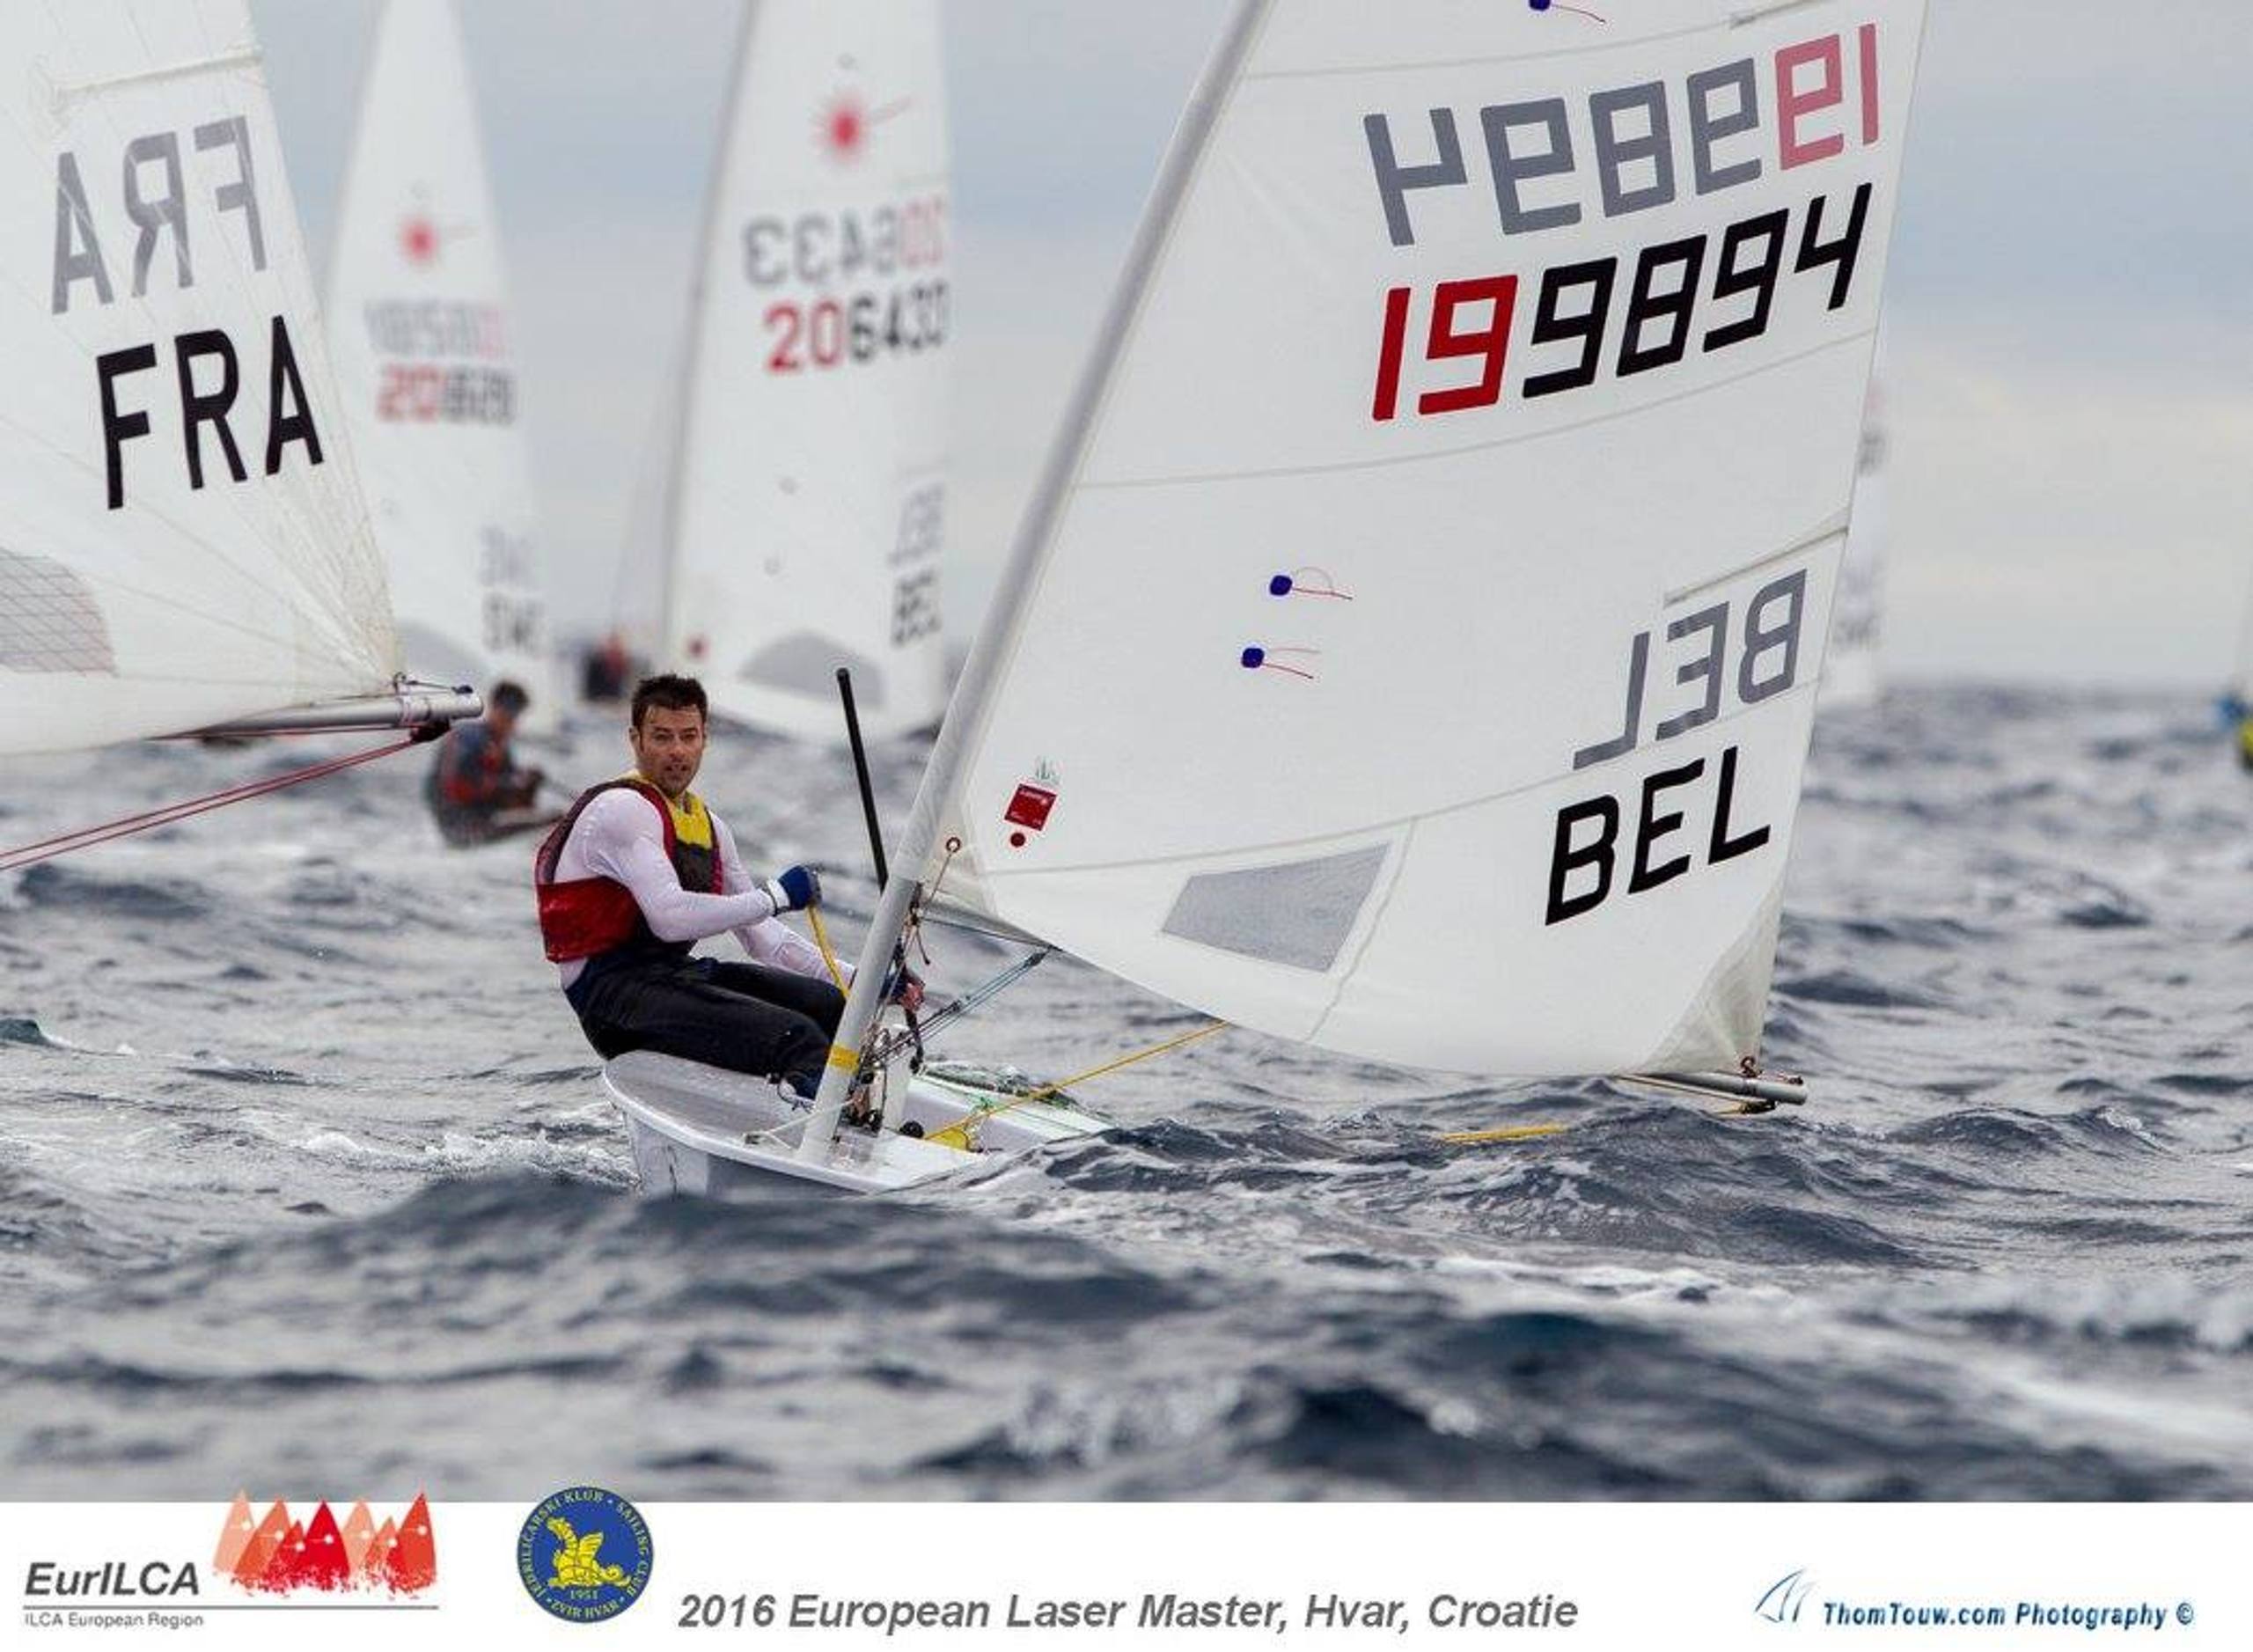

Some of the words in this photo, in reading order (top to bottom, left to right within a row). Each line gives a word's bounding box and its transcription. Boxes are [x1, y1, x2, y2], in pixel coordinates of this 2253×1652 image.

[1371, 182, 1873, 422] 199894
[96, 314, 325, 510] FRA
[1545, 745, 1771, 926] BEL
